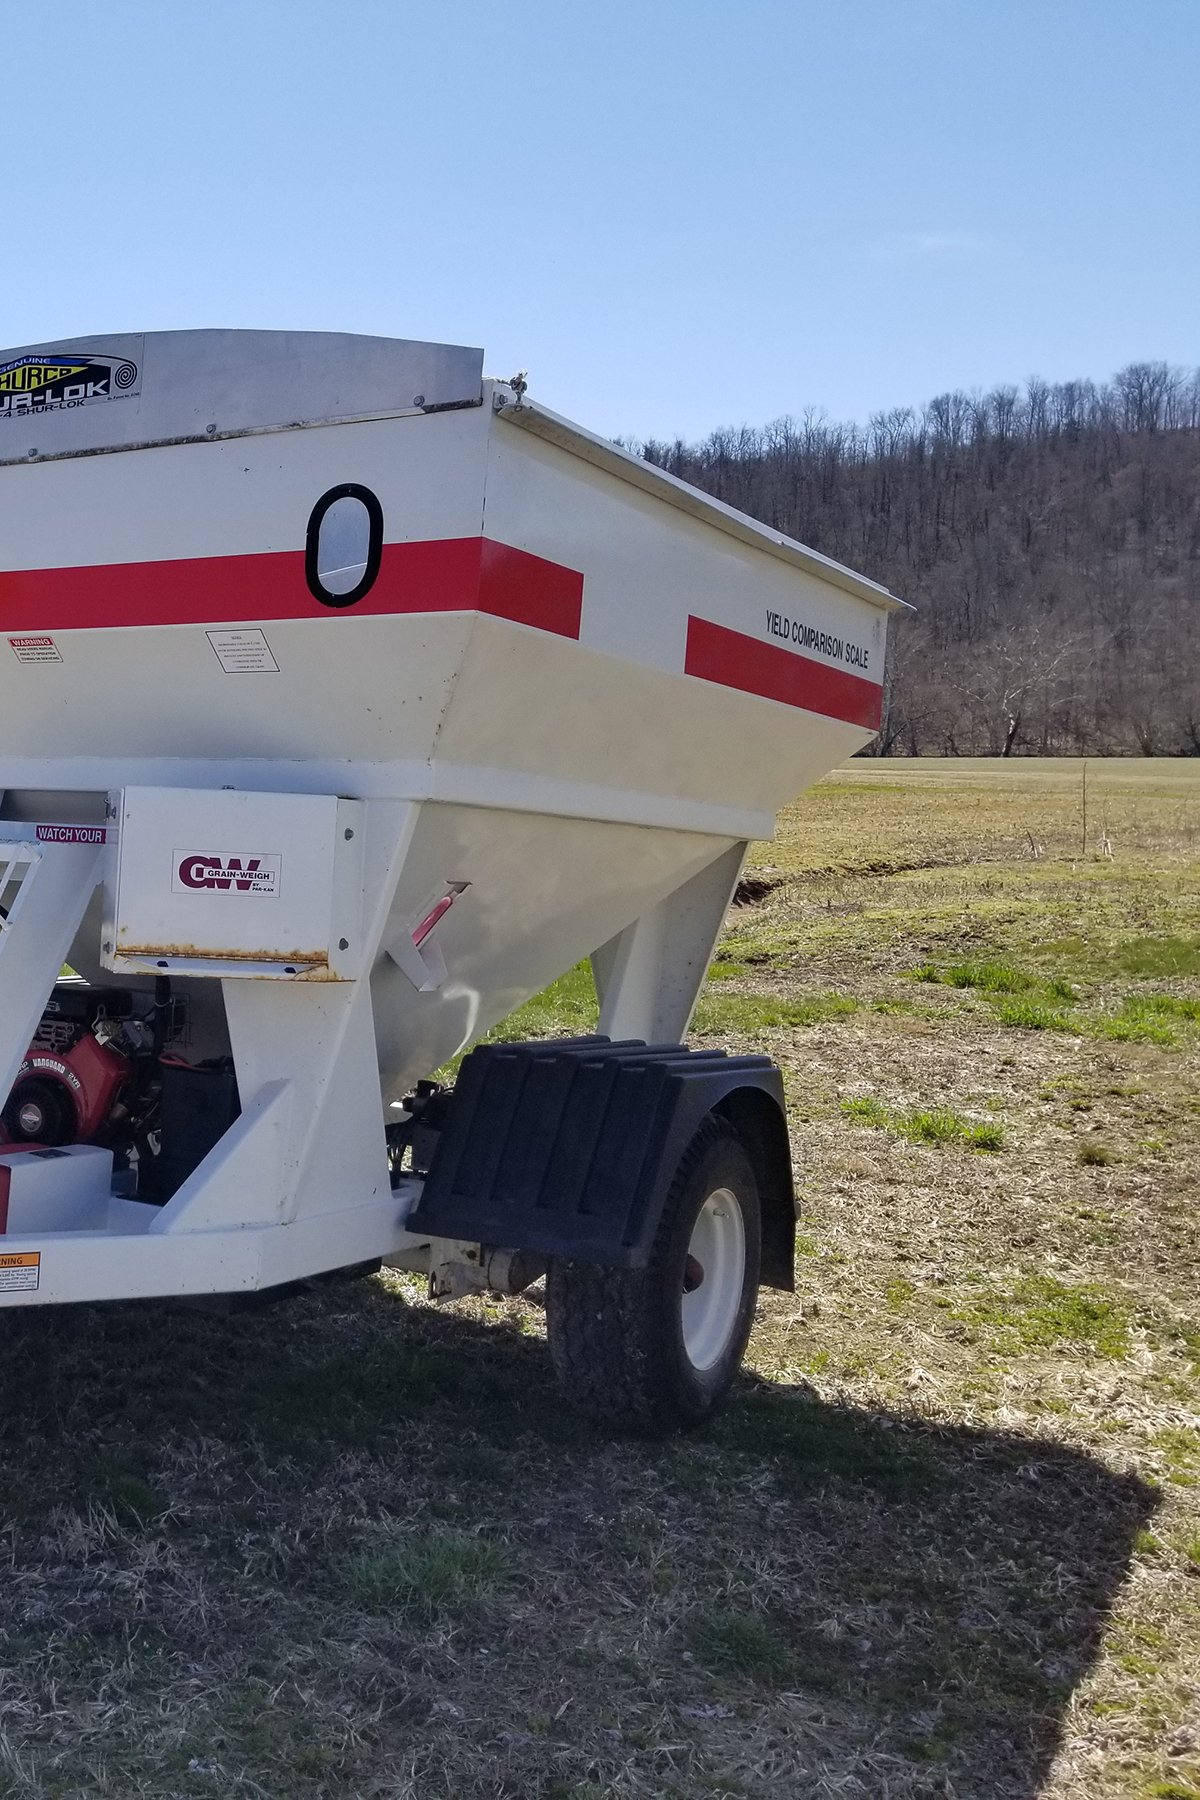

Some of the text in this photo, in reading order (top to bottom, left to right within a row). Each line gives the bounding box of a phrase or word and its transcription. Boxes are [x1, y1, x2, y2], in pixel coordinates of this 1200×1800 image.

[17, 399, 85, 417] SHUR-LOK
[12, 638, 51, 646] WARNING
[766, 610, 868, 669] YIELD COMPARISON SCALE
[38, 827, 103, 843] WATCH YOUR
[207, 869, 270, 880] GRAIN-WEIGH
[32, 1058, 66, 1074] VANGUARD
